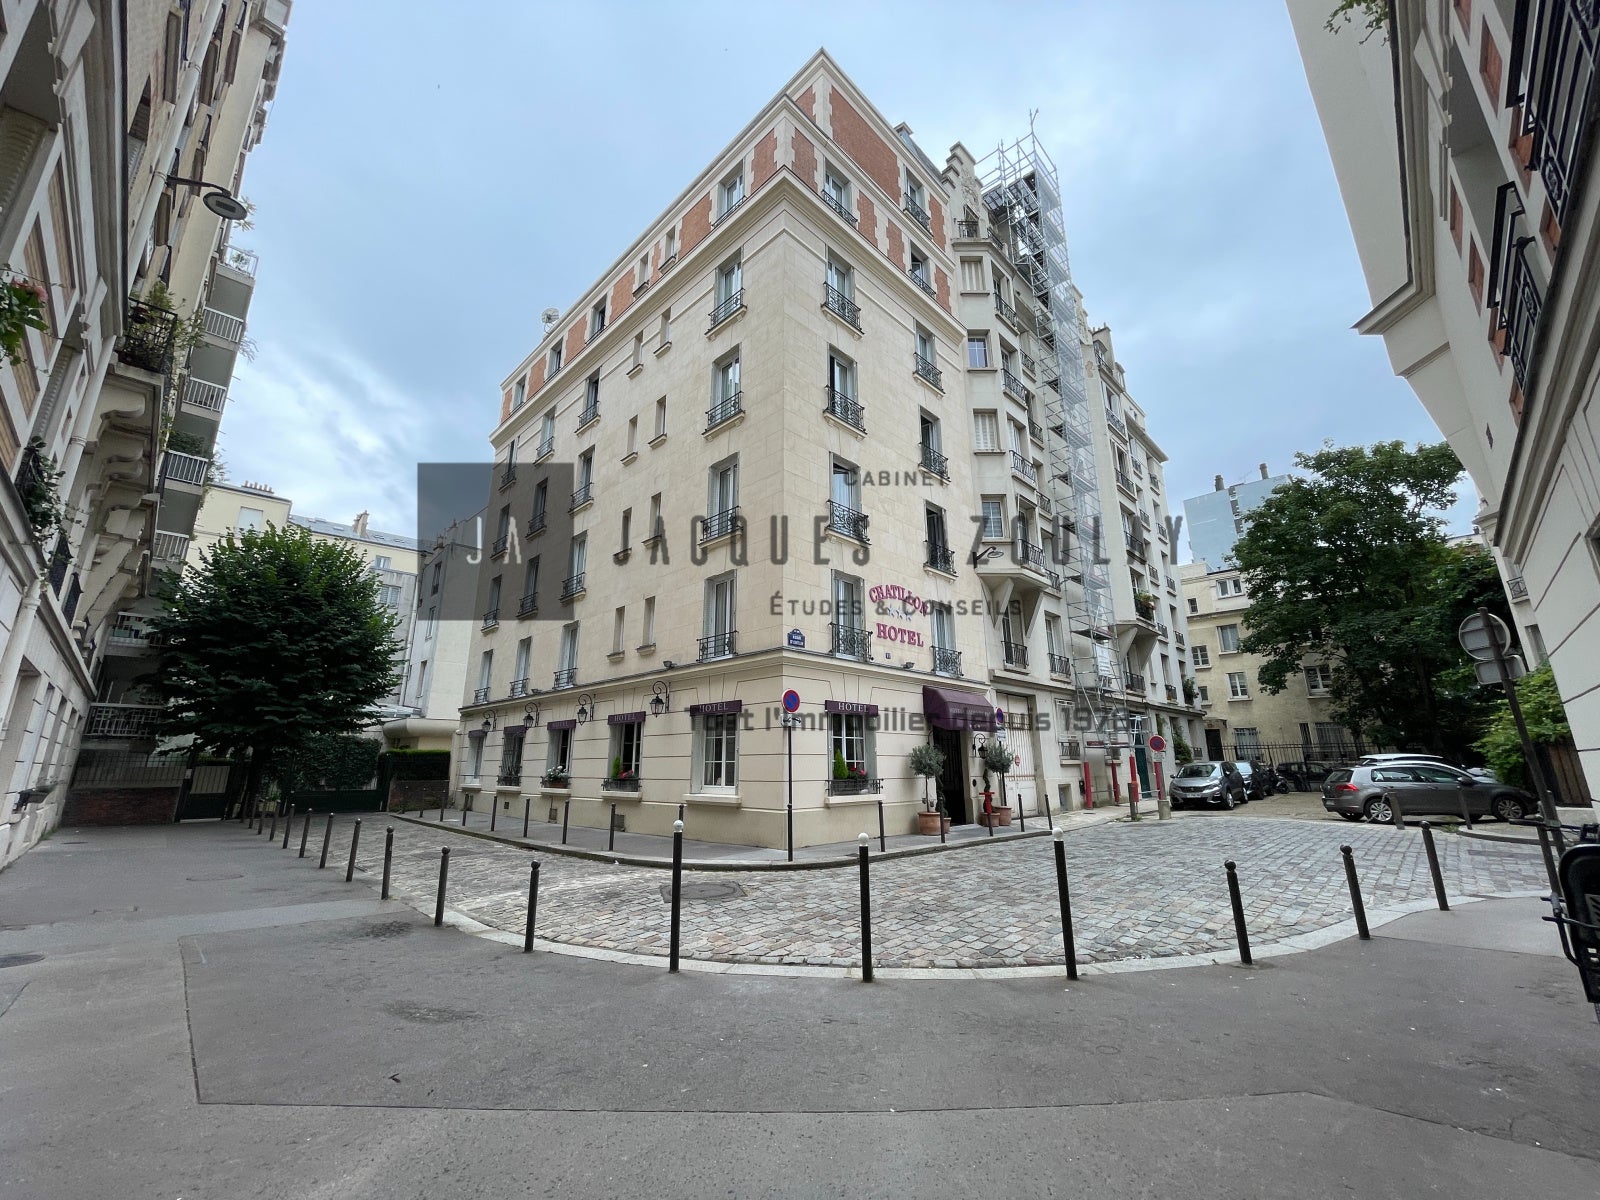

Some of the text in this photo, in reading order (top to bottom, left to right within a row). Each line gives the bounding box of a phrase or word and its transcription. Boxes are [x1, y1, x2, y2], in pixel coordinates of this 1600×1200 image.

[868, 584, 929, 617] CHATILLON
[876, 623, 924, 647] HOTEL
[699, 703, 728, 713] HOTEL
[838, 702, 868, 713] HOTEL
